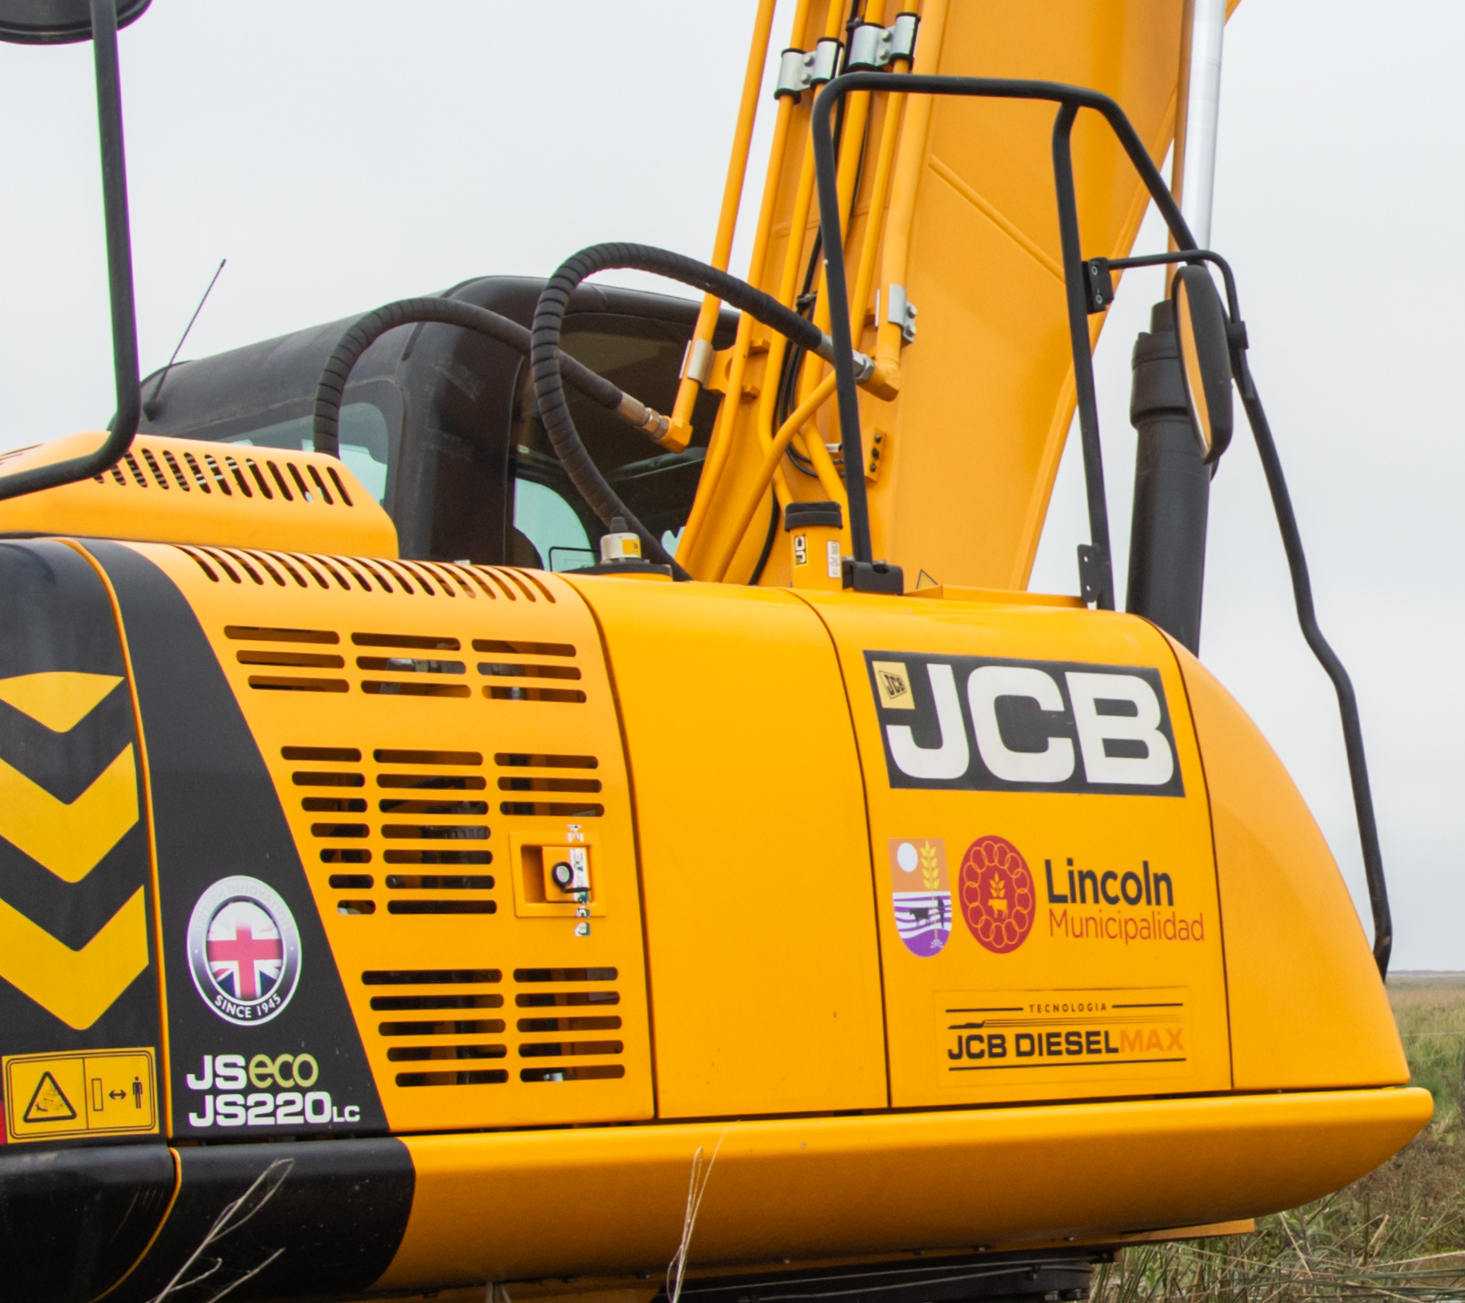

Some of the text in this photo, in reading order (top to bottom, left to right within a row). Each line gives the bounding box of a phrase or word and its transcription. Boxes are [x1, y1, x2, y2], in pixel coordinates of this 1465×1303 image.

[883, 673, 906, 698] JCB
[885, 663, 1174, 785] JCB
[1044, 857, 1174, 907] Lincoln
[1049, 908, 1205, 946] Municipalidad
[214, 993, 282, 1019] SINCE 1945
[1029, 1002, 1108, 1014] TECNOLOGIA
[947, 1034, 1007, 1060] JCB
